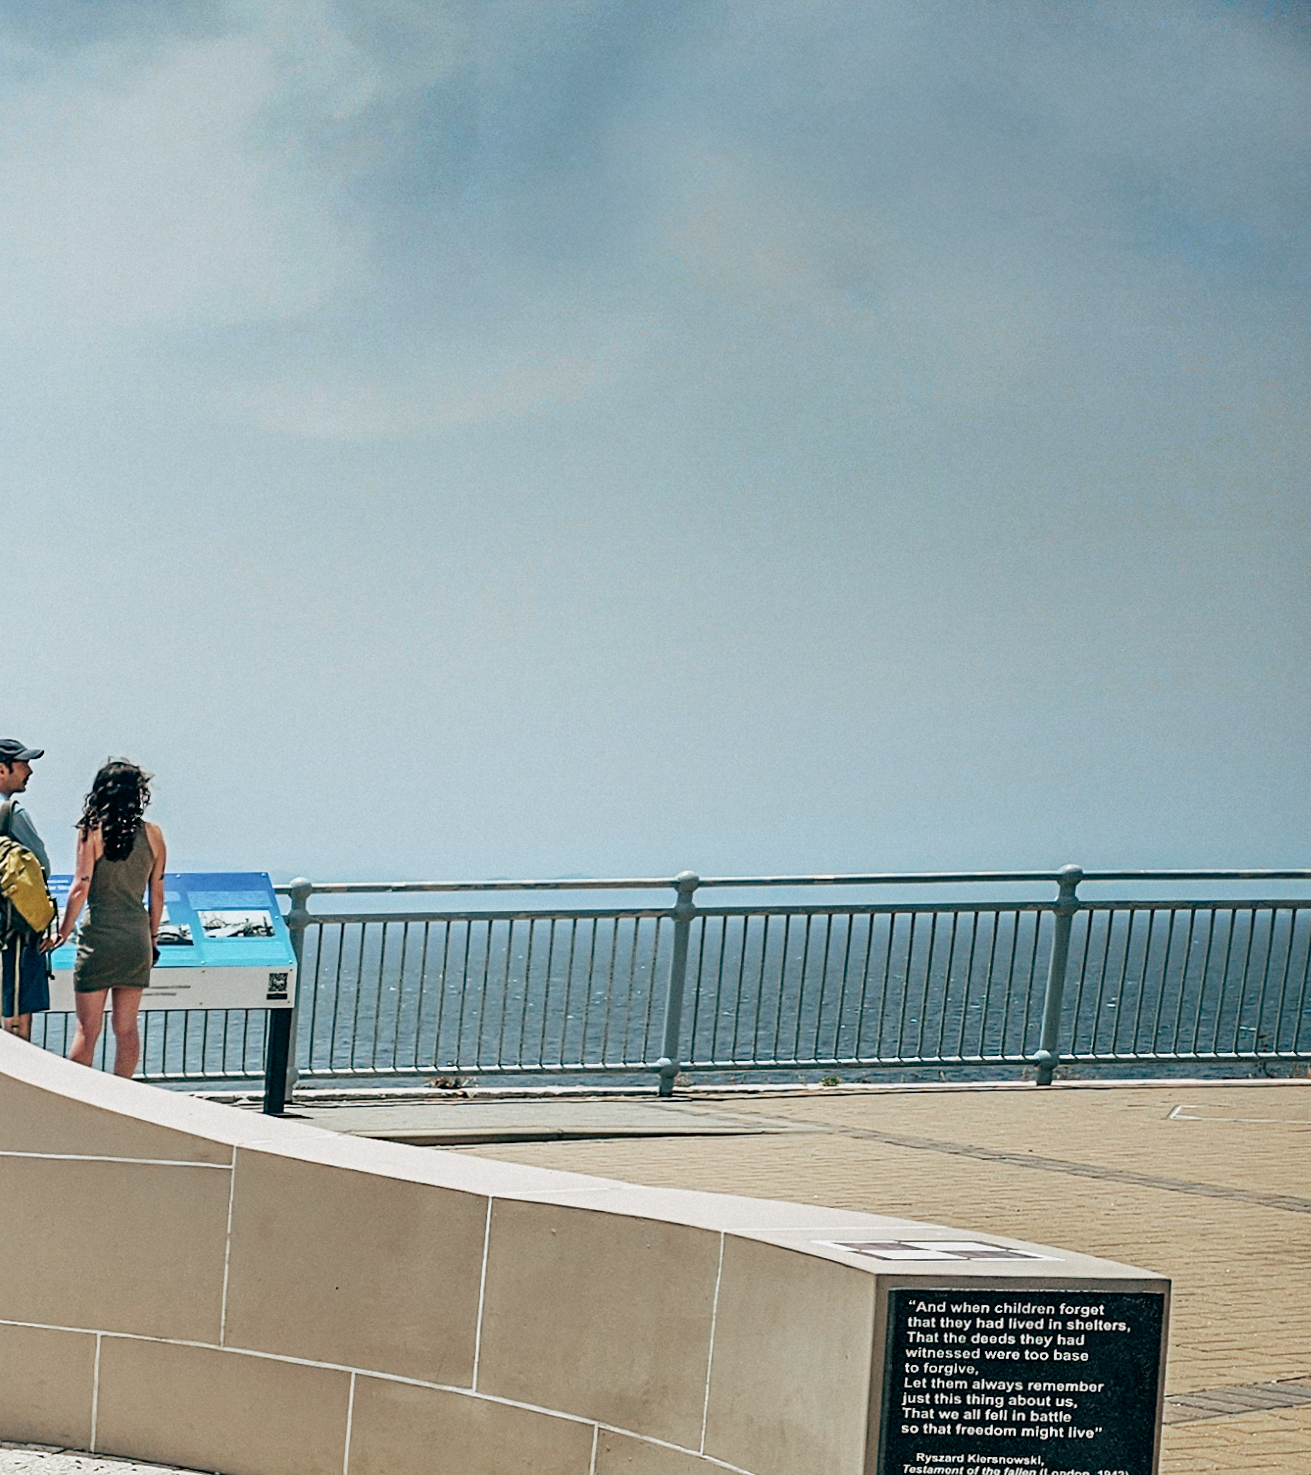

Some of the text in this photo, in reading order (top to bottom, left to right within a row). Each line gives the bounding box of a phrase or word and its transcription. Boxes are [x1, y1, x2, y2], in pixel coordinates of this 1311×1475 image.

[951, 1302, 990, 1313] when
[994, 1302, 1055, 1314] children
[1059, 1303, 1104, 1317] forget
[908, 1317, 1130, 1332] that they had lived in shelters,
[907, 1331, 1085, 1348] That the deeds they had
[905, 1347, 1089, 1361] witnessed were too base
[905, 1362, 979, 1376] to forgive,
[904, 1377, 1104, 1393] Let them always remember
[901, 1392, 1077, 1409] just this thing about us,
[902, 1407, 1072, 1422] That we all fell in battle
[901, 1425, 919, 1434] so
[923, 1423, 951, 1435] that
[956, 1424, 1016, 1436] freedom
[1021, 1426, 1064, 1440] might
[916, 1453, 1044, 1466] Ryszard Kiersnowski,
[903, 1464, 964, 1475] Testament
[967, 1466, 980, 1475] of
[982, 1467, 1001, 1475] the
